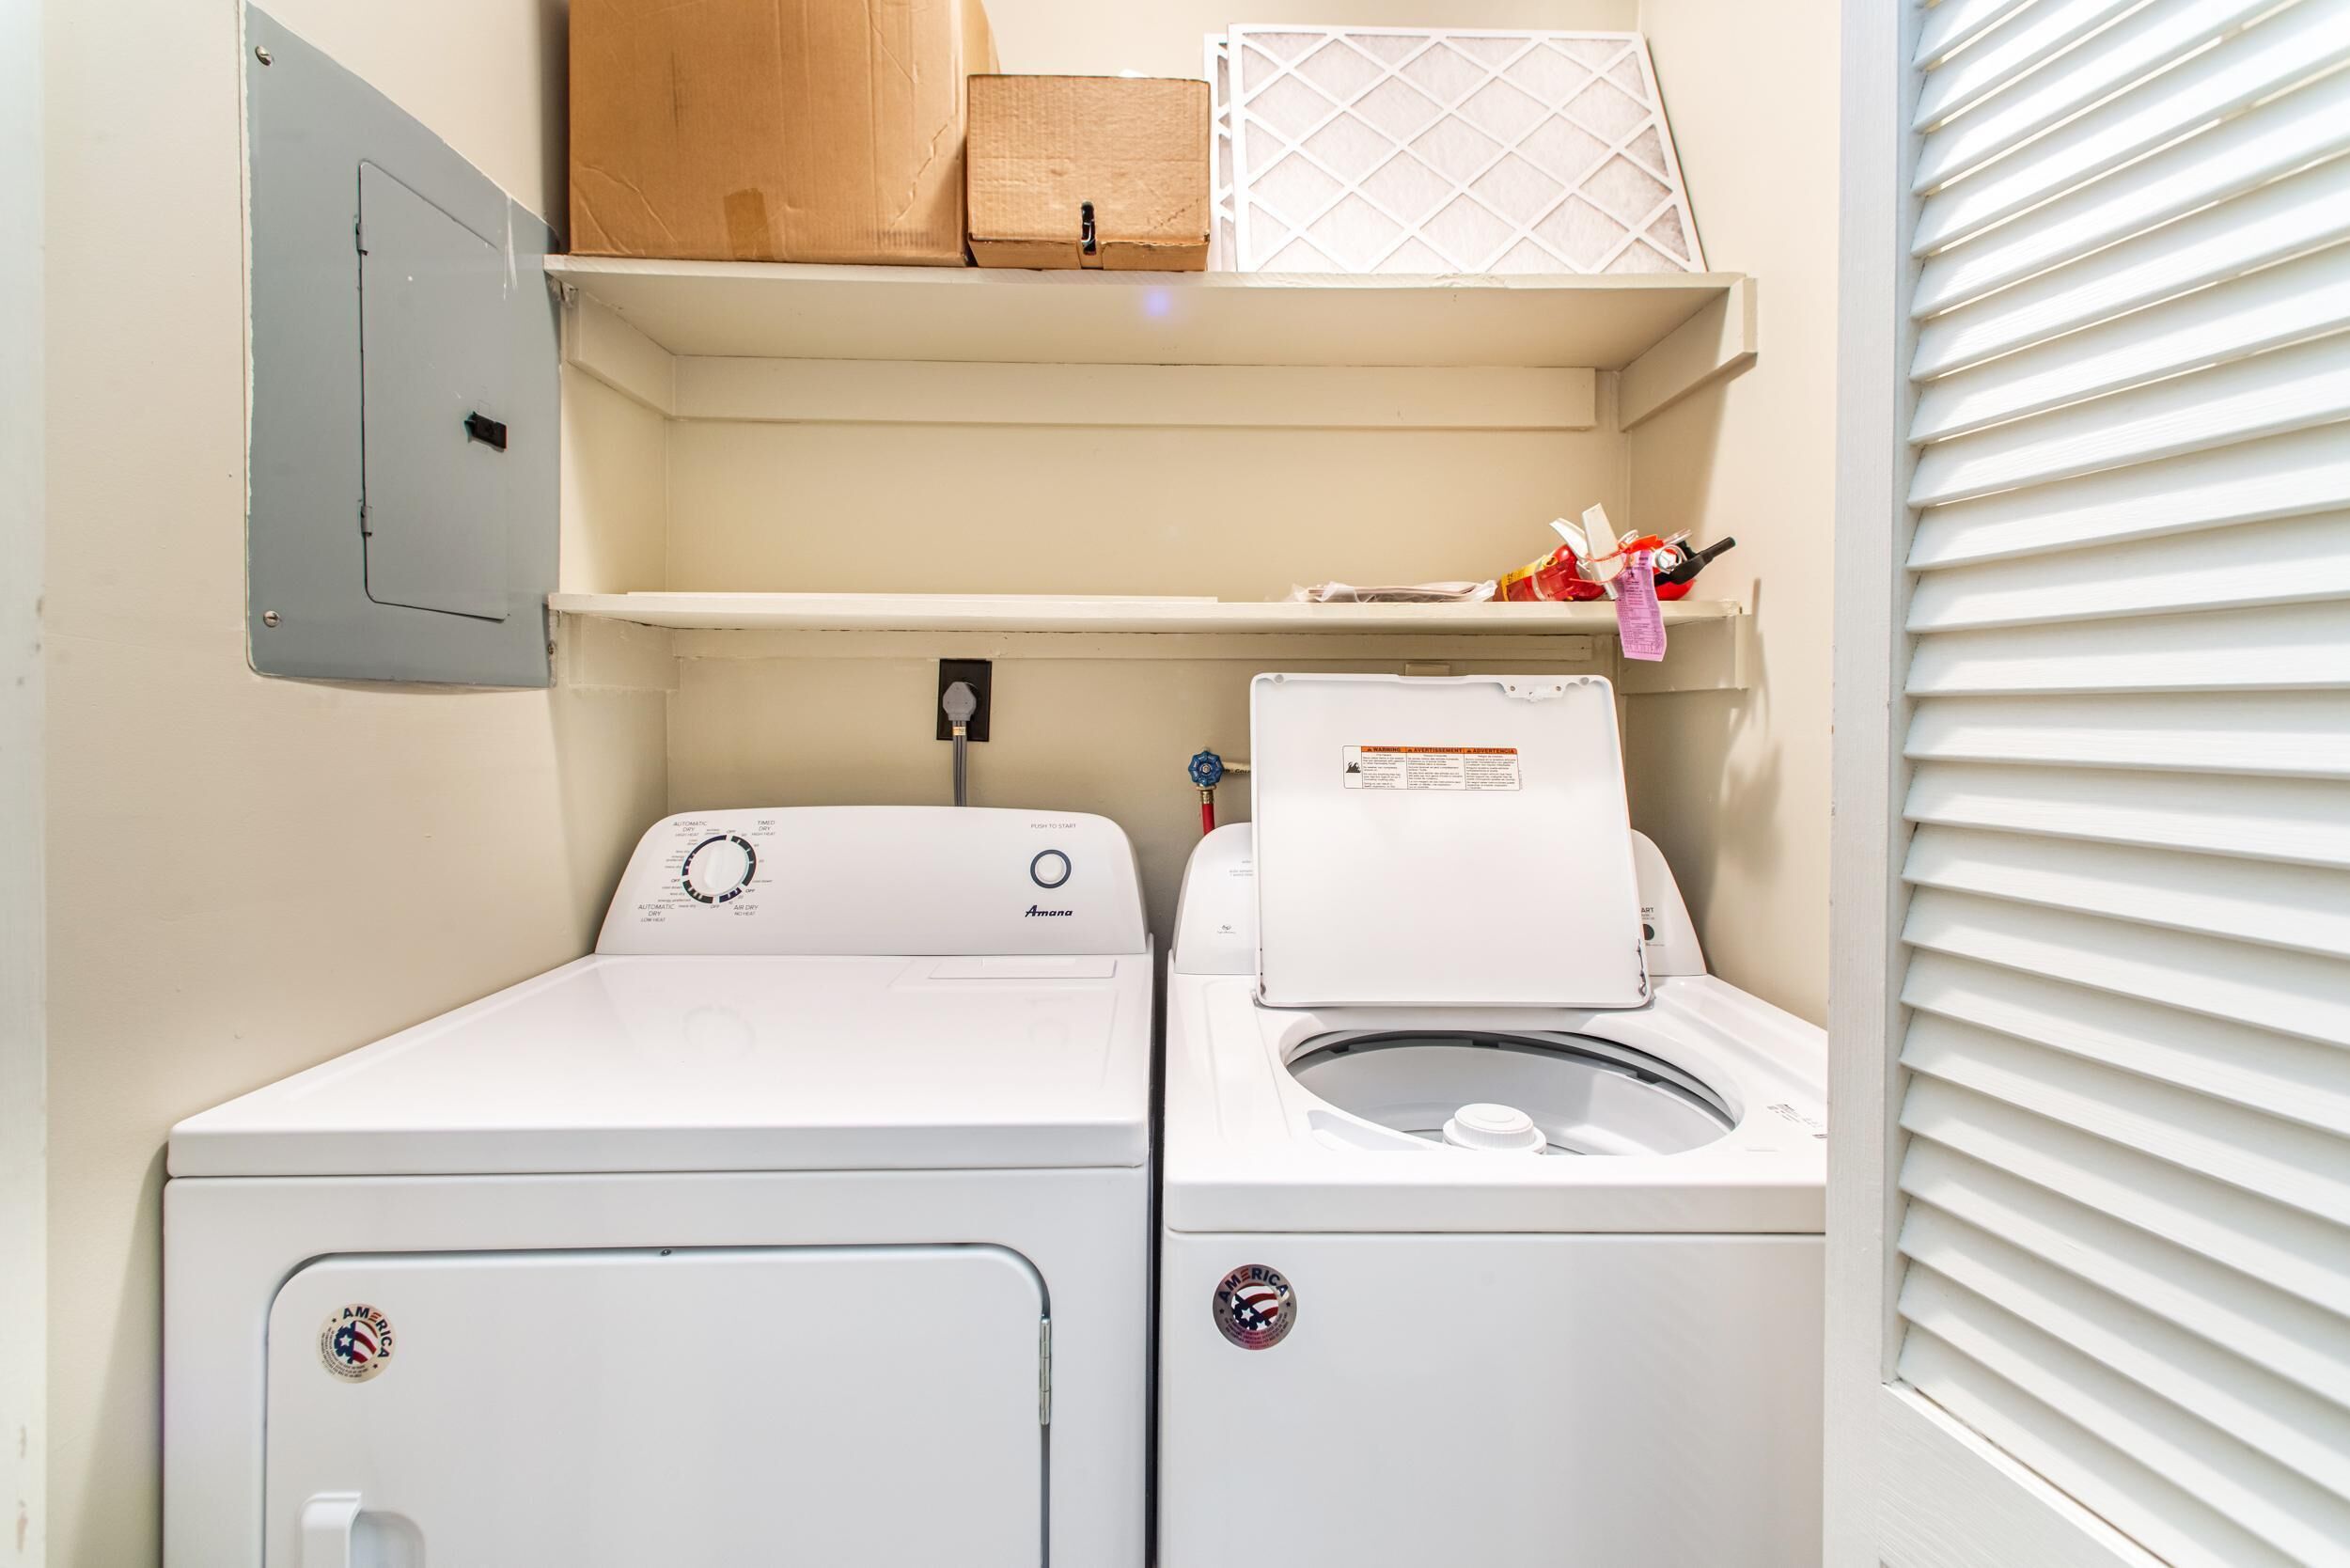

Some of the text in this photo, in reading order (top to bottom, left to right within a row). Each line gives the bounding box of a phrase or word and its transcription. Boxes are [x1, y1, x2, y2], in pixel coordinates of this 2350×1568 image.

[1025, 904, 1073, 917] Amana
[1218, 1267, 1289, 1303] AMERICA
[342, 1306, 393, 1358] AMERICA
